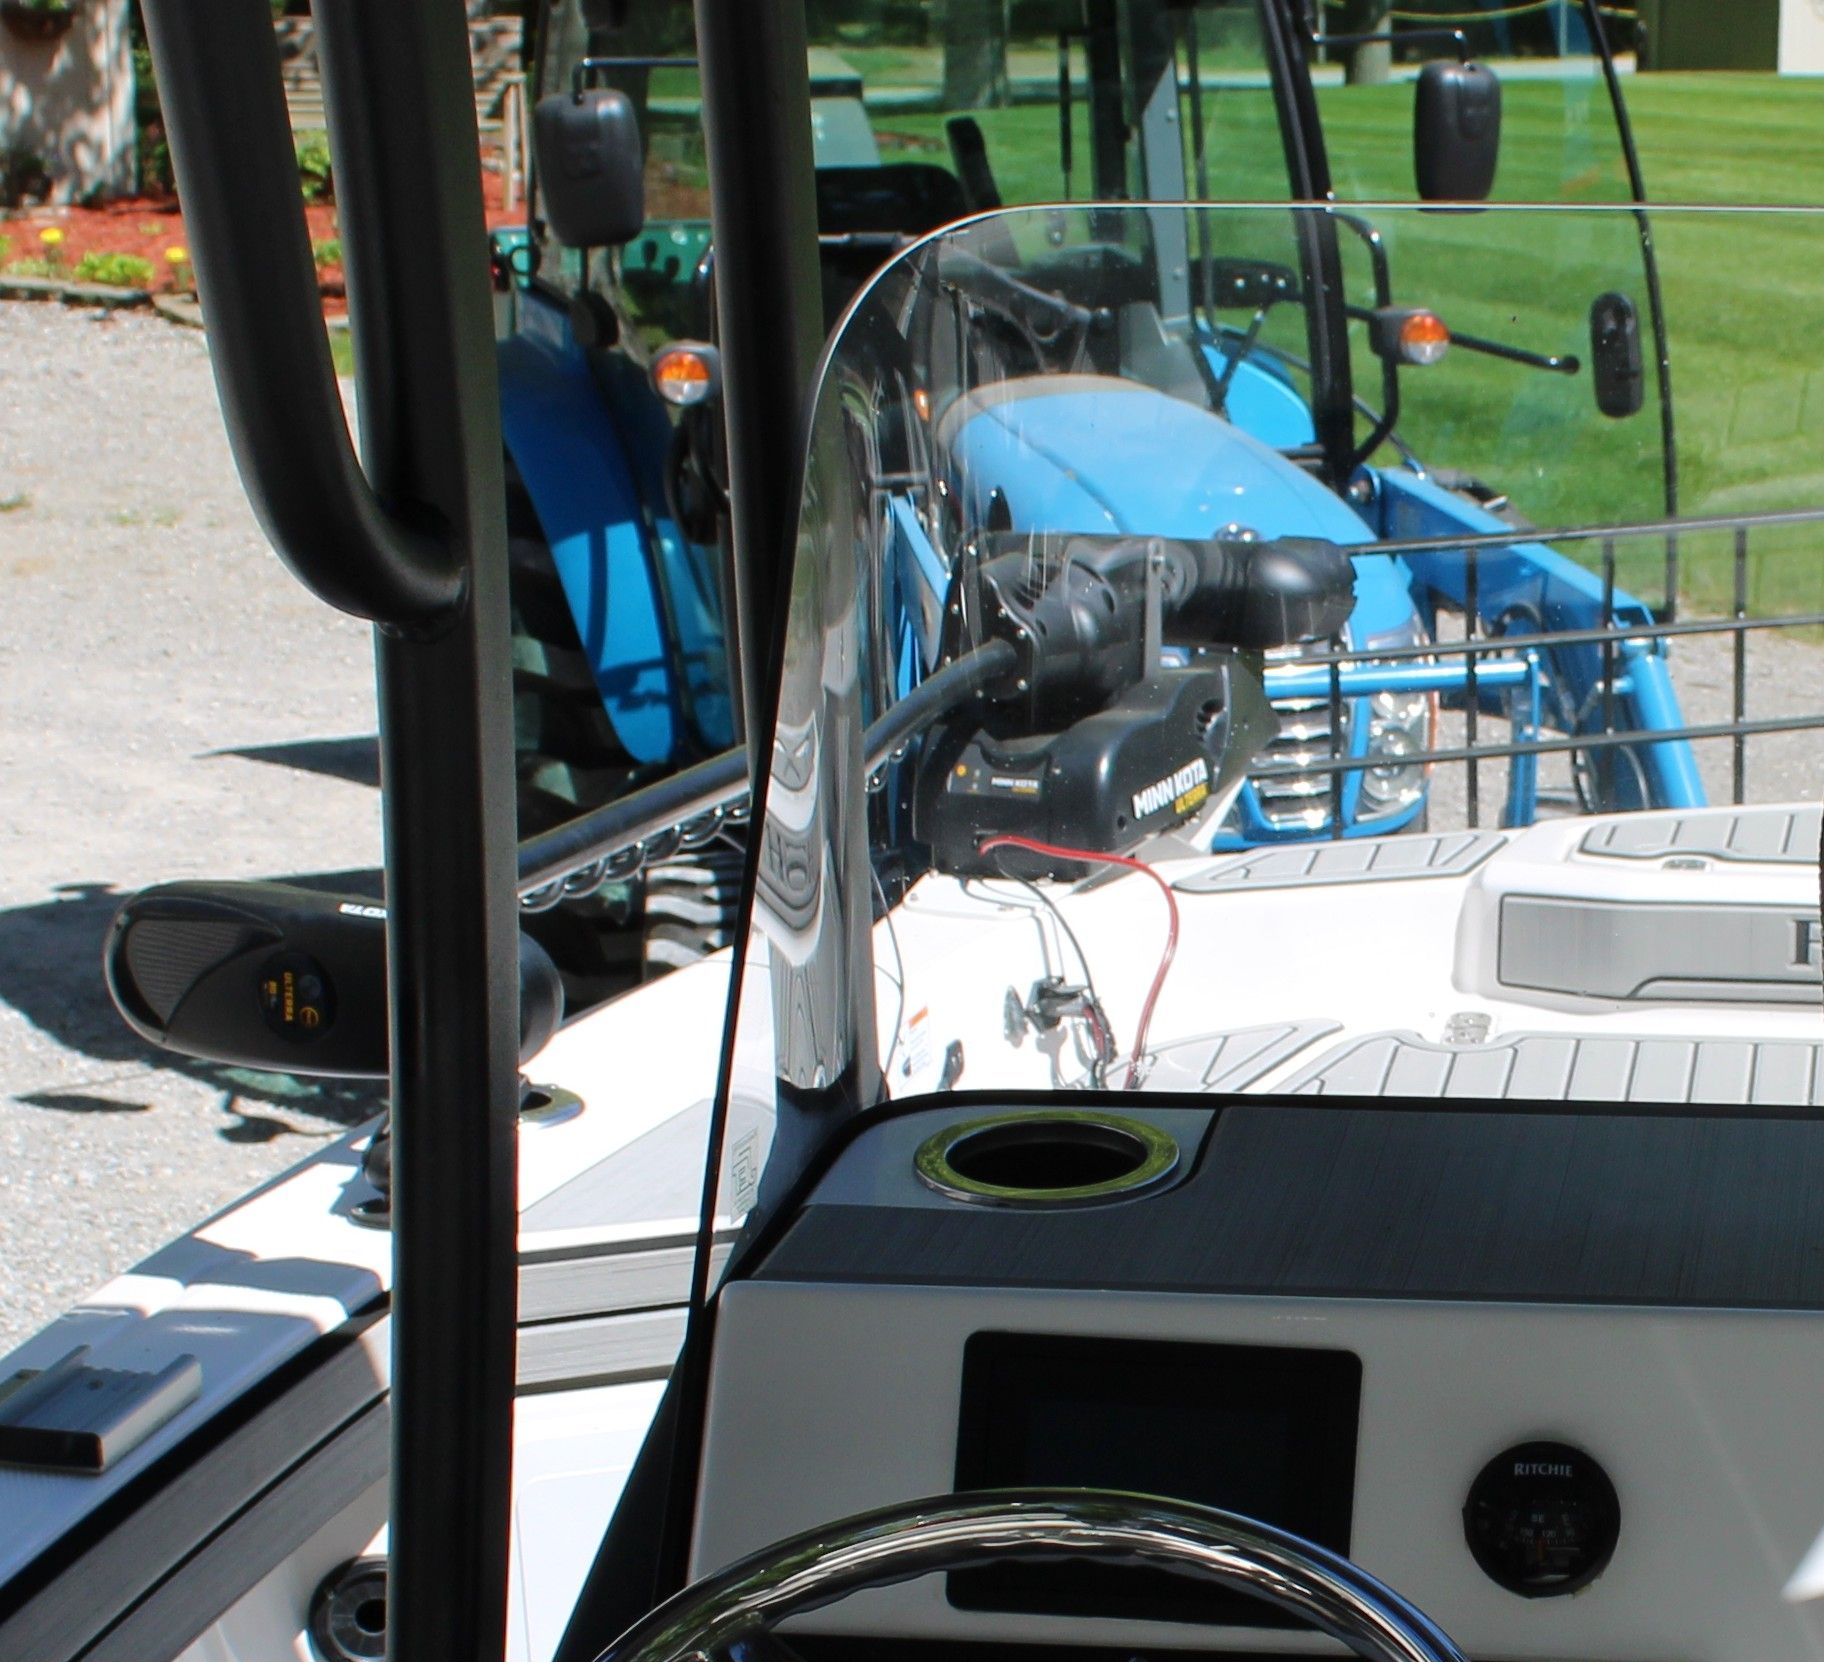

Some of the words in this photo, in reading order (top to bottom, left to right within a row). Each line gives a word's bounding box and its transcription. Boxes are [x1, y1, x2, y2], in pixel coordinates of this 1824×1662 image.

[1131, 776, 1174, 821] MINN
[1173, 757, 1209, 795] KOTA
[1513, 1462, 1574, 1477] RITCHIE
